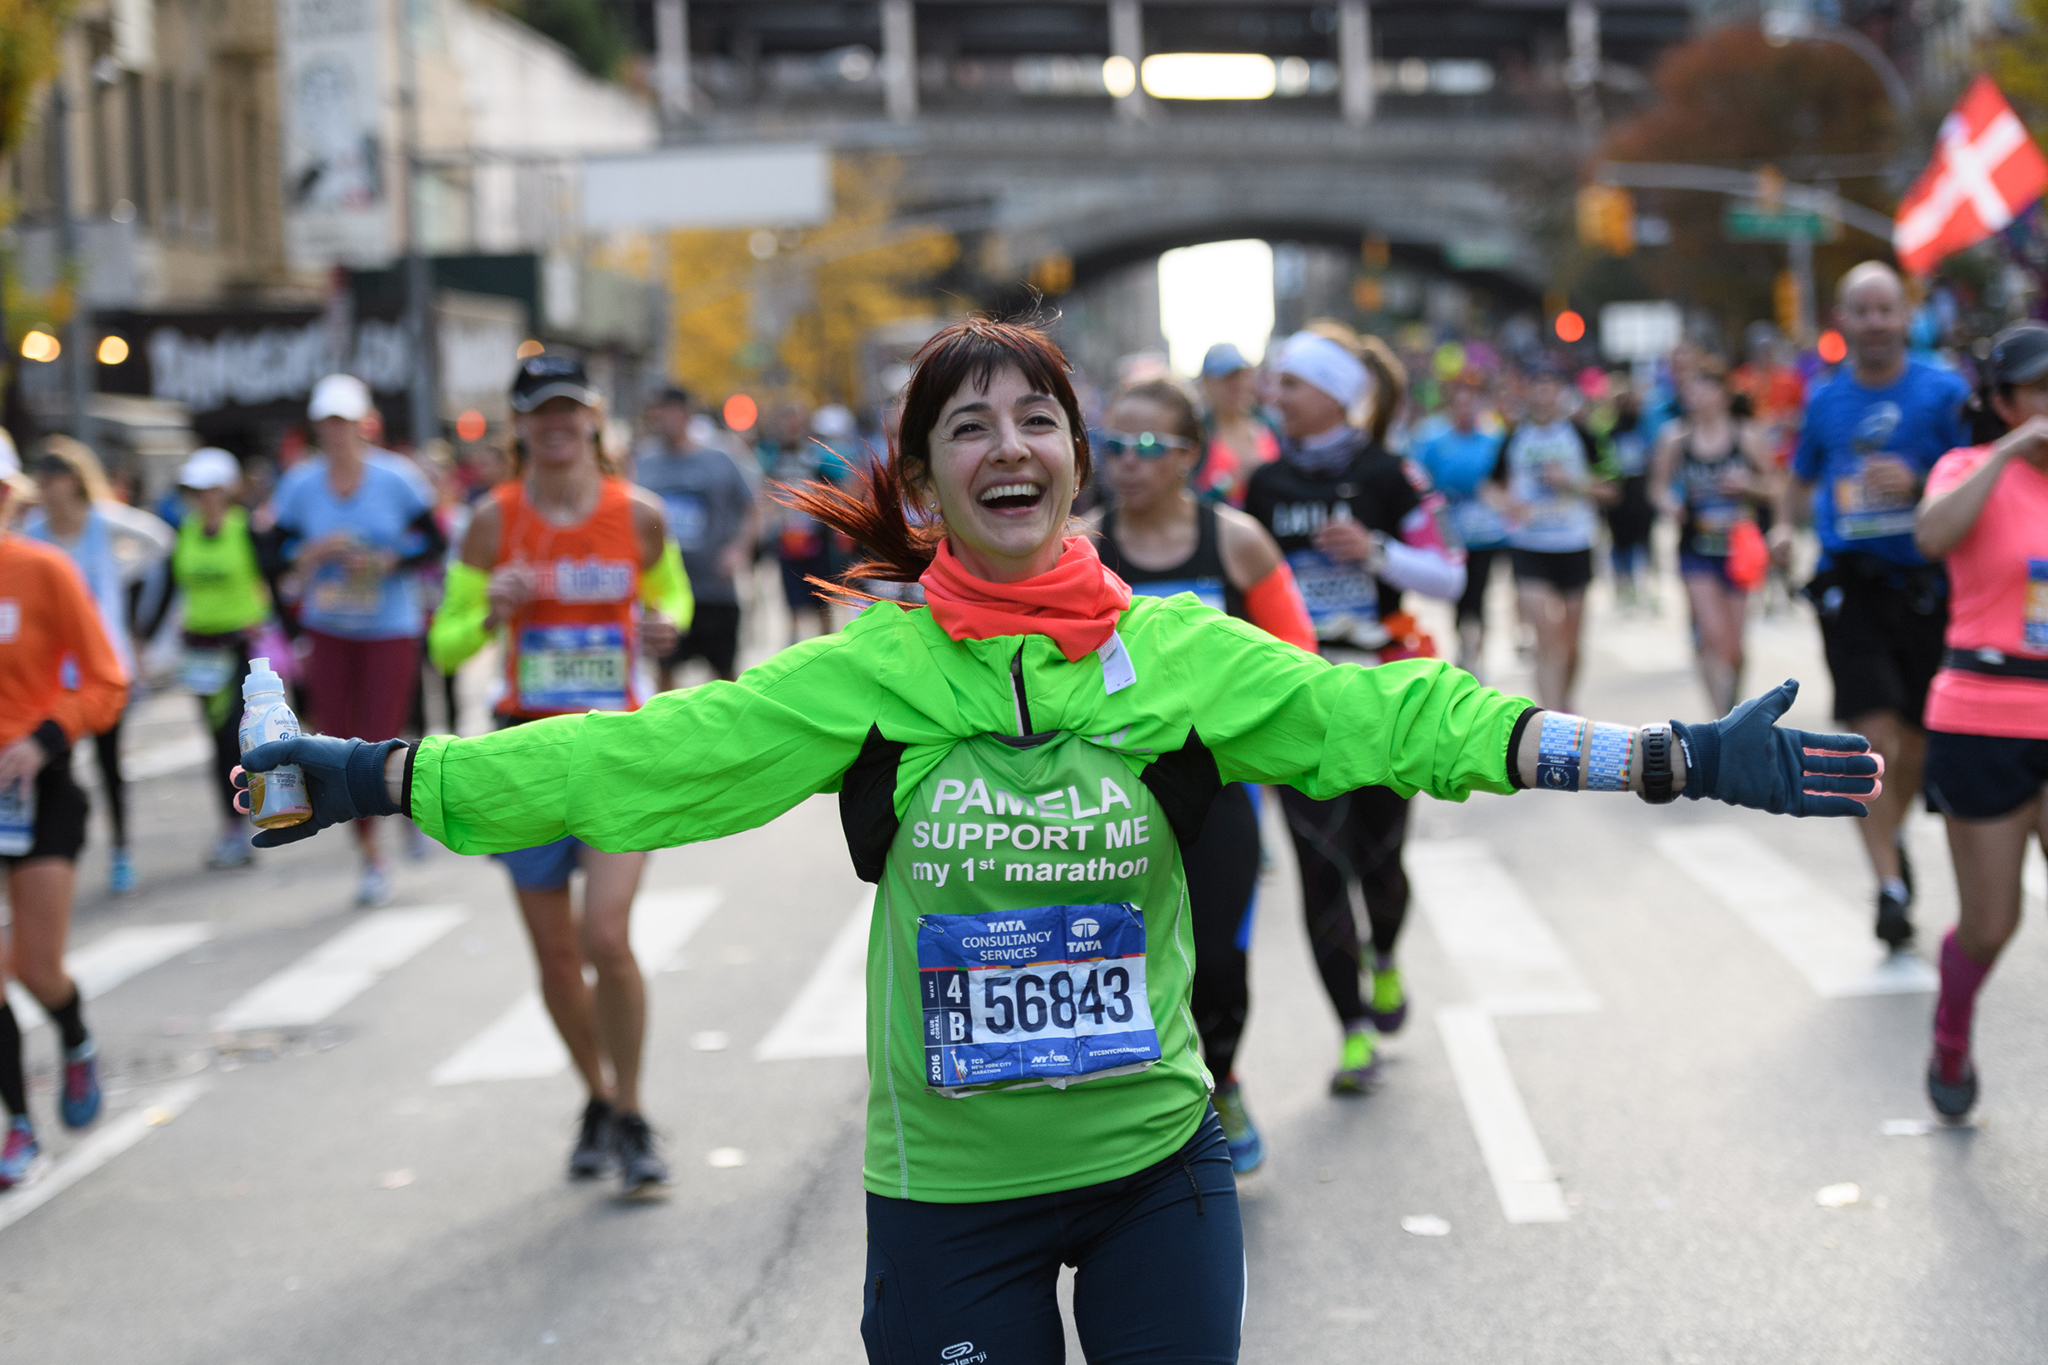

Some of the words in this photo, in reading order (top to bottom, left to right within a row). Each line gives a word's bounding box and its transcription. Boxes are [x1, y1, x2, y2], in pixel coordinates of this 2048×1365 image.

[931, 777, 1132, 820] PAMELA
[912, 821, 1094, 851] SUPPORT
[1105, 815, 1150, 850] ME
[912, 861, 950, 888] my
[961, 857, 995, 882] 1st
[1005, 856, 1149, 882] marathon
[962, 931, 1053, 948] CONSULTANCY
[987, 920, 1027, 933] TATA
[980, 947, 1038, 961] SERVICES
[1066, 940, 1102, 953] TATA
[947, 974, 963, 1004] 4
[985, 966, 1134, 1034] 56843
[949, 1011, 966, 1042] B
[931, 1054, 942, 1081] 2016
